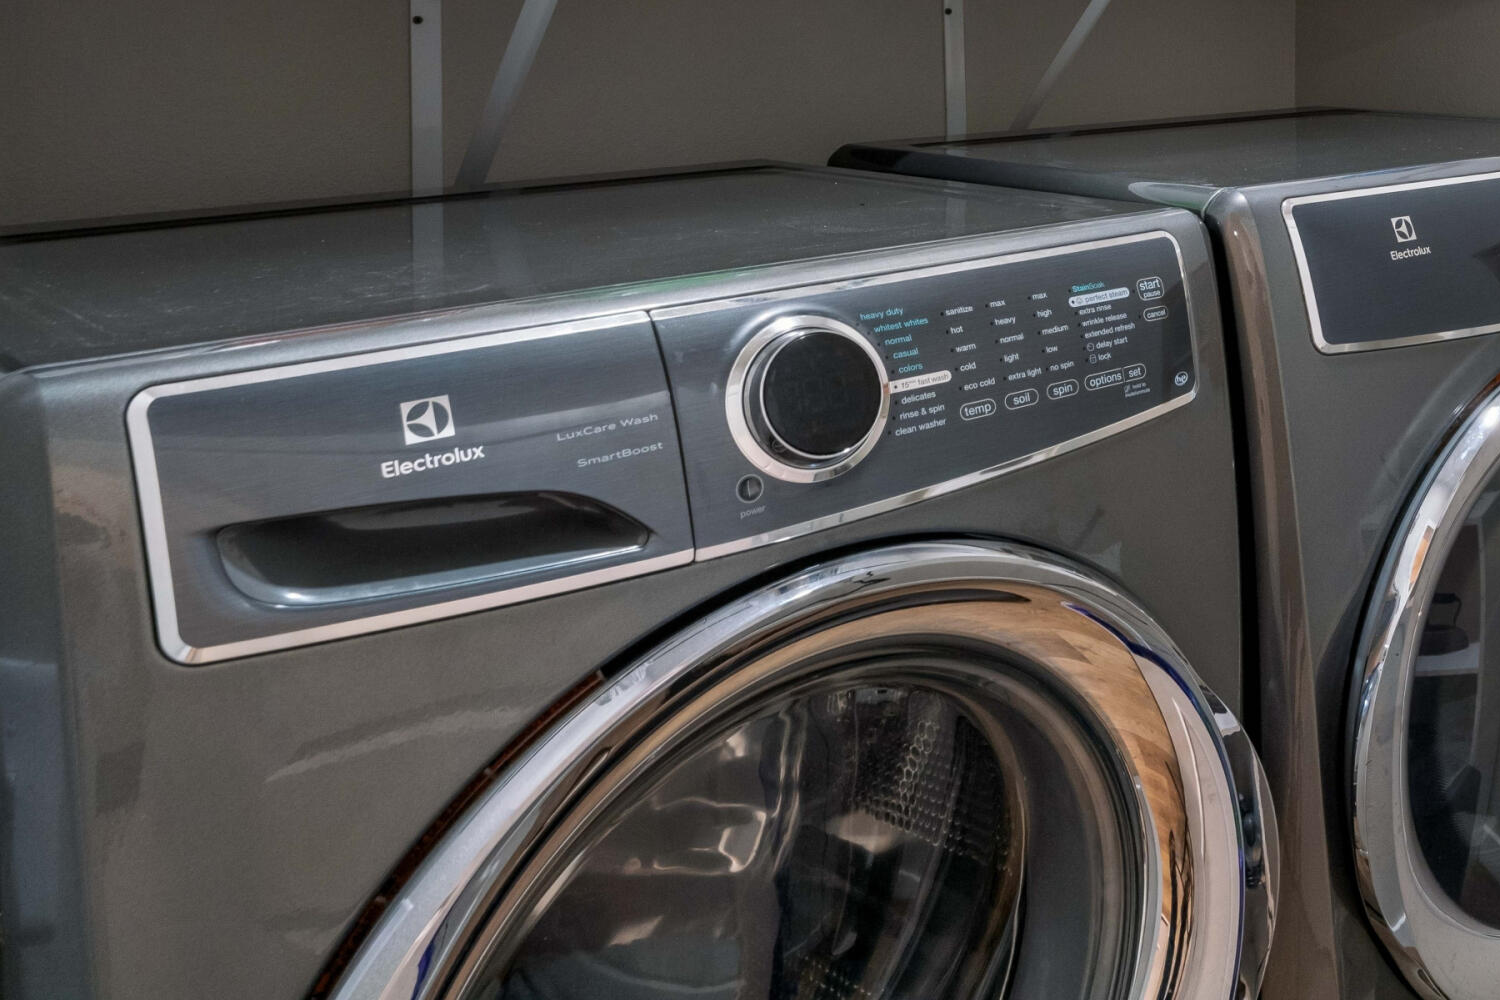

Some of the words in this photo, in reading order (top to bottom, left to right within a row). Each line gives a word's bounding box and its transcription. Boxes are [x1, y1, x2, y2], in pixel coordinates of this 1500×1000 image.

[1390, 245, 1432, 261] Electrolux
[1139, 279, 1160, 291] start
[1032, 292, 1048, 300] max
[1143, 289, 1161, 298] pause
[990, 300, 1006, 308] max
[860, 311, 884, 321] heavy
[886, 307, 904, 316] duty
[945, 305, 973, 316] sanitize
[1037, 309, 1052, 318] high
[1147, 309, 1166, 319] cancel
[874, 322, 902, 333] whitest
[904, 317, 929, 327] whites
[994, 316, 1016, 326] heavy
[1082, 317, 1104, 327] wrinkle
[1105, 312, 1127, 322] release
[950, 325, 964, 334] hot
[1042, 324, 1069, 335] medium
[1084, 327, 1114, 339] extended
[1114, 322, 1136, 332] refresh
[885, 334, 912, 345] normal
[1000, 332, 1024, 344] normal
[1096, 340, 1112, 349] delay
[1113, 336, 1128, 345] start
[893, 348, 919, 359] casual
[956, 343, 976, 352] warm
[1004, 353, 1019, 363] light
[1098, 352, 1112, 360] lock
[898, 362, 923, 373] colors
[960, 362, 976, 372] cold
[1060, 360, 1074, 371] spin
[1008, 372, 1026, 381] extra
[1027, 367, 1042, 378] light
[1089, 372, 1122, 388] options
[1128, 368, 1142, 378] set
[964, 382, 978, 391] eco
[979, 377, 996, 387] cold
[1052, 383, 1073, 397] spin
[901, 391, 936, 405] delicates
[1013, 393, 1031, 405] soil
[899, 408, 919, 420] rinse
[921, 406, 927, 415] &
[928, 404, 945, 415] spin
[964, 403, 992, 417] temp
[556, 421, 617, 442] LuxCare
[620, 413, 659, 428] Wash
[895, 425, 917, 437] clean
[918, 418, 946, 430] washer
[577, 442, 664, 468] SmartBoost
[380, 445, 485, 479] Electrolux
